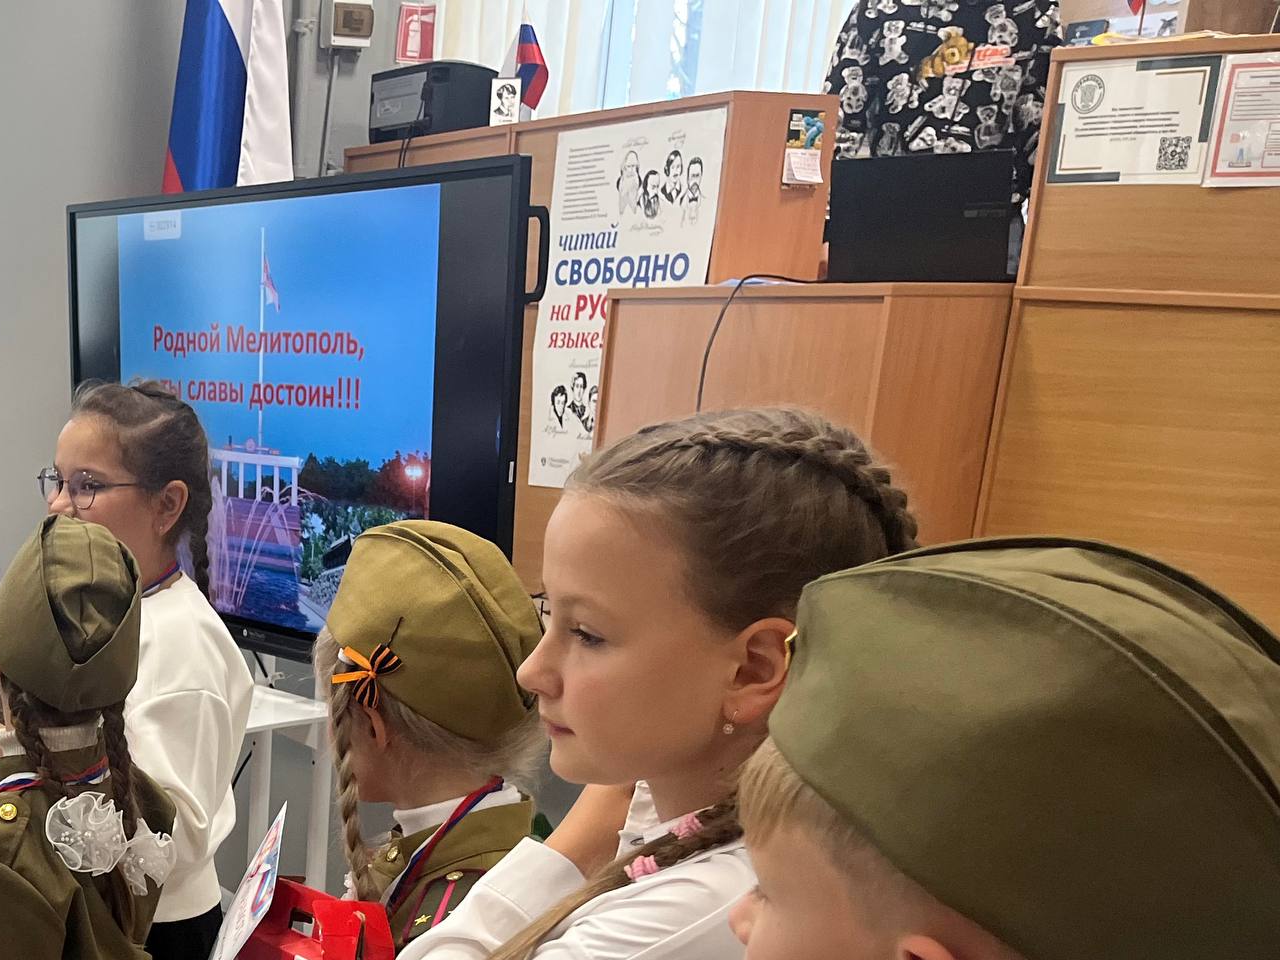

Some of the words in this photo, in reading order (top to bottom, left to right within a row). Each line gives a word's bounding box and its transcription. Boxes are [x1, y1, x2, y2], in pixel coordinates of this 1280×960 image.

[558, 222, 619, 252] читай
[554, 252, 690, 288] СВОБОДНО
[550, 304, 571, 321] на
[153, 323, 220, 359] Родной
[226, 325, 364, 361] Мелитополь,
[187, 379, 244, 403] славы
[249, 376, 360, 411] достоин!!!
